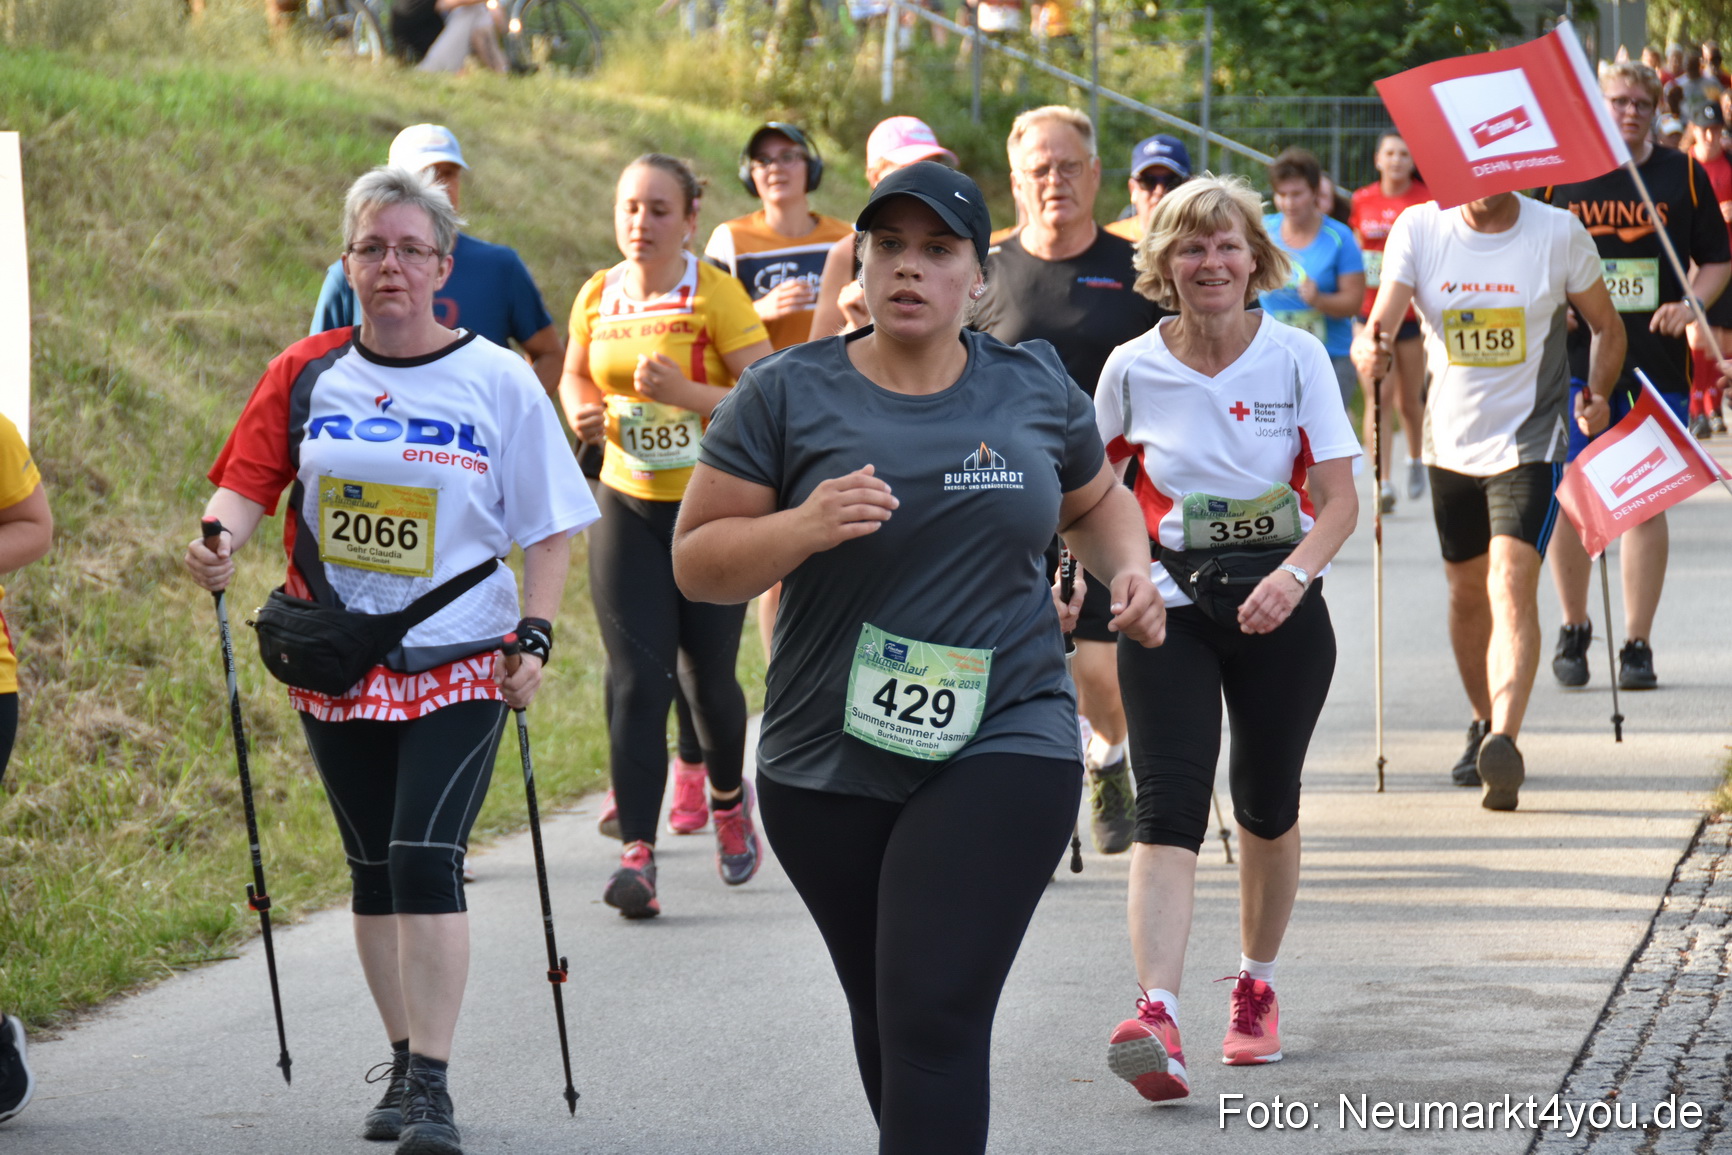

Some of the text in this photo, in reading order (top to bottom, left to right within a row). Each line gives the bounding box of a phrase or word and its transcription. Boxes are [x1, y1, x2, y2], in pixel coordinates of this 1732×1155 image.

[1472, 155, 1565, 177] DEHN protects.
[1580, 200, 1669, 226] WINGS
[1462, 283, 1520, 293] KLEBL
[640, 319, 694, 336] BÖGL
[1455, 328, 1514, 350] 1158
[627, 424, 690, 450] 1583
[403, 448, 488, 474] energie
[1626, 461, 1652, 484] DEHN
[944, 471, 1024, 484] BURKHARDT
[1612, 472, 1696, 521] DEHN protects.
[332, 510, 418, 550] 2066
[1209, 516, 1275, 542] 359
[346, 544, 402, 559] Gehr Claudia
[371, 556, 390, 565] GmbH
[871, 652, 929, 677] firmenlauf
[367, 674, 440, 702] AVIA
[958, 680, 981, 690] 2019
[872, 677, 956, 729] 429
[852, 706, 969, 743] Summersammer Jasmin
[877, 729, 914, 746] Burkhardt
[915, 739, 940, 750] GmbH
